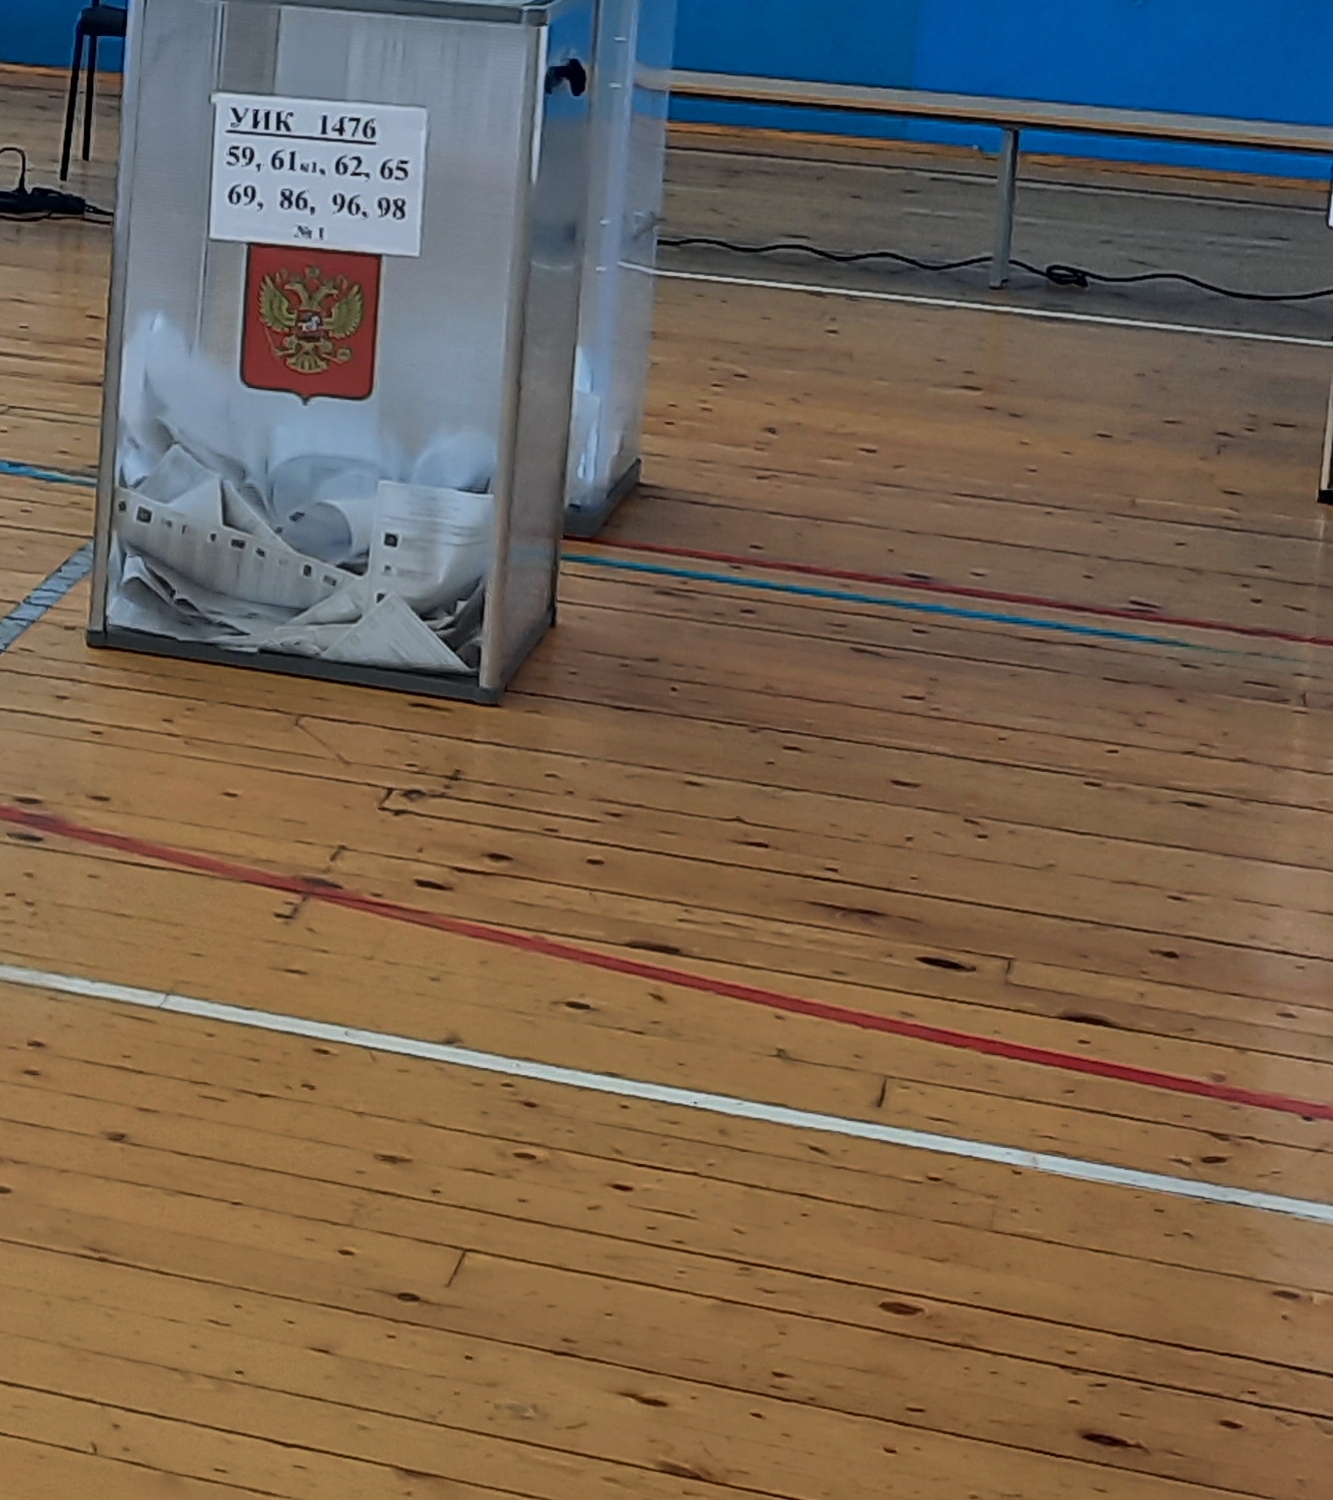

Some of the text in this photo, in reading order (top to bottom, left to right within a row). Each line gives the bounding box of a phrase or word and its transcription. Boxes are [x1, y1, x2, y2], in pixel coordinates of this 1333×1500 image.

[230, 106, 377, 139] УИК 1476
[225, 145, 265, 172] 59,
[334, 154, 371, 182] 62,
[379, 158, 410, 181] 65
[227, 183, 407, 220] 69, 86, 96, 98
